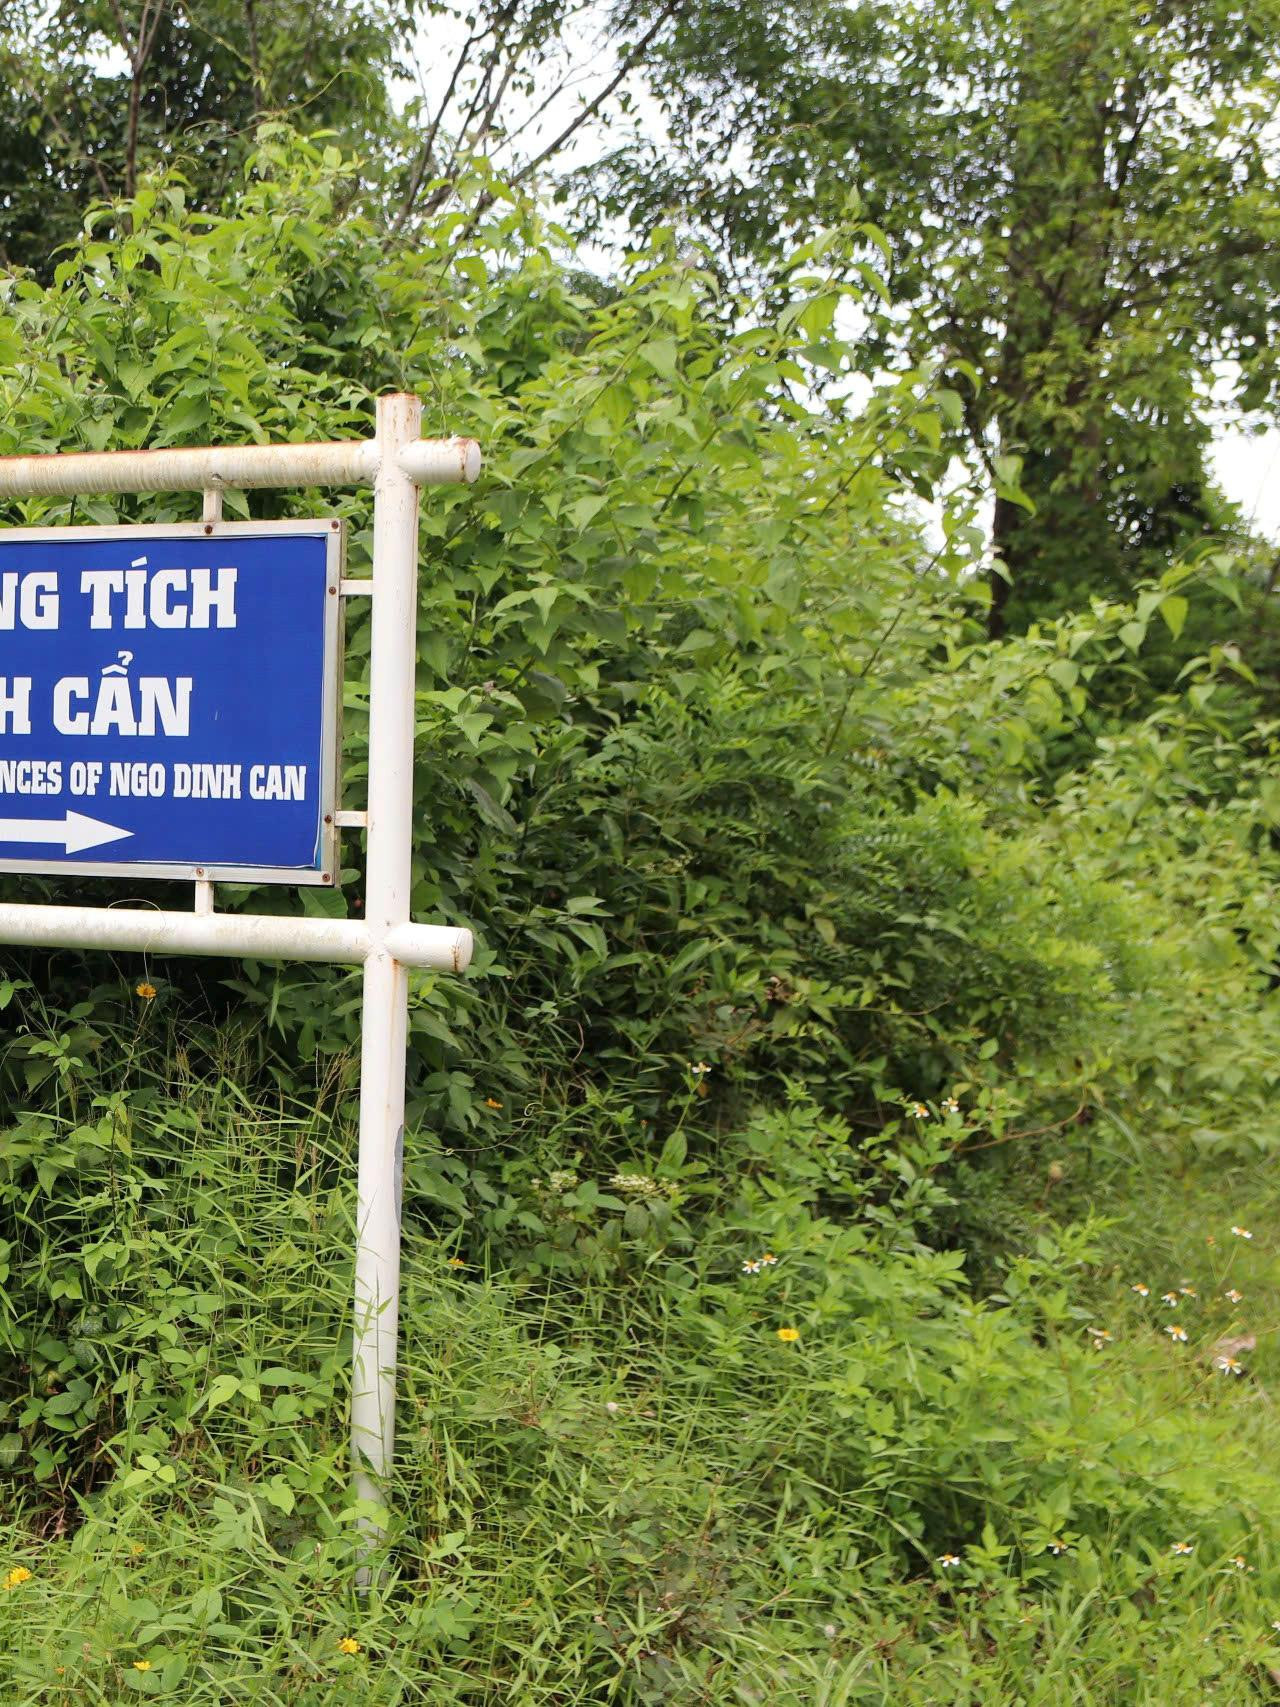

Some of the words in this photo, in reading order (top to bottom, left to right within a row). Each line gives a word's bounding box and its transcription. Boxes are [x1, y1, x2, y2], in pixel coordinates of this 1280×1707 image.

[81, 557, 237, 629] TÍCH
[53, 651, 192, 736] CẨN
[70, 762, 102, 795] OF
[110, 763, 165, 797] NGO
[174, 764, 241, 799] DINH
[250, 765, 306, 800] CAN
